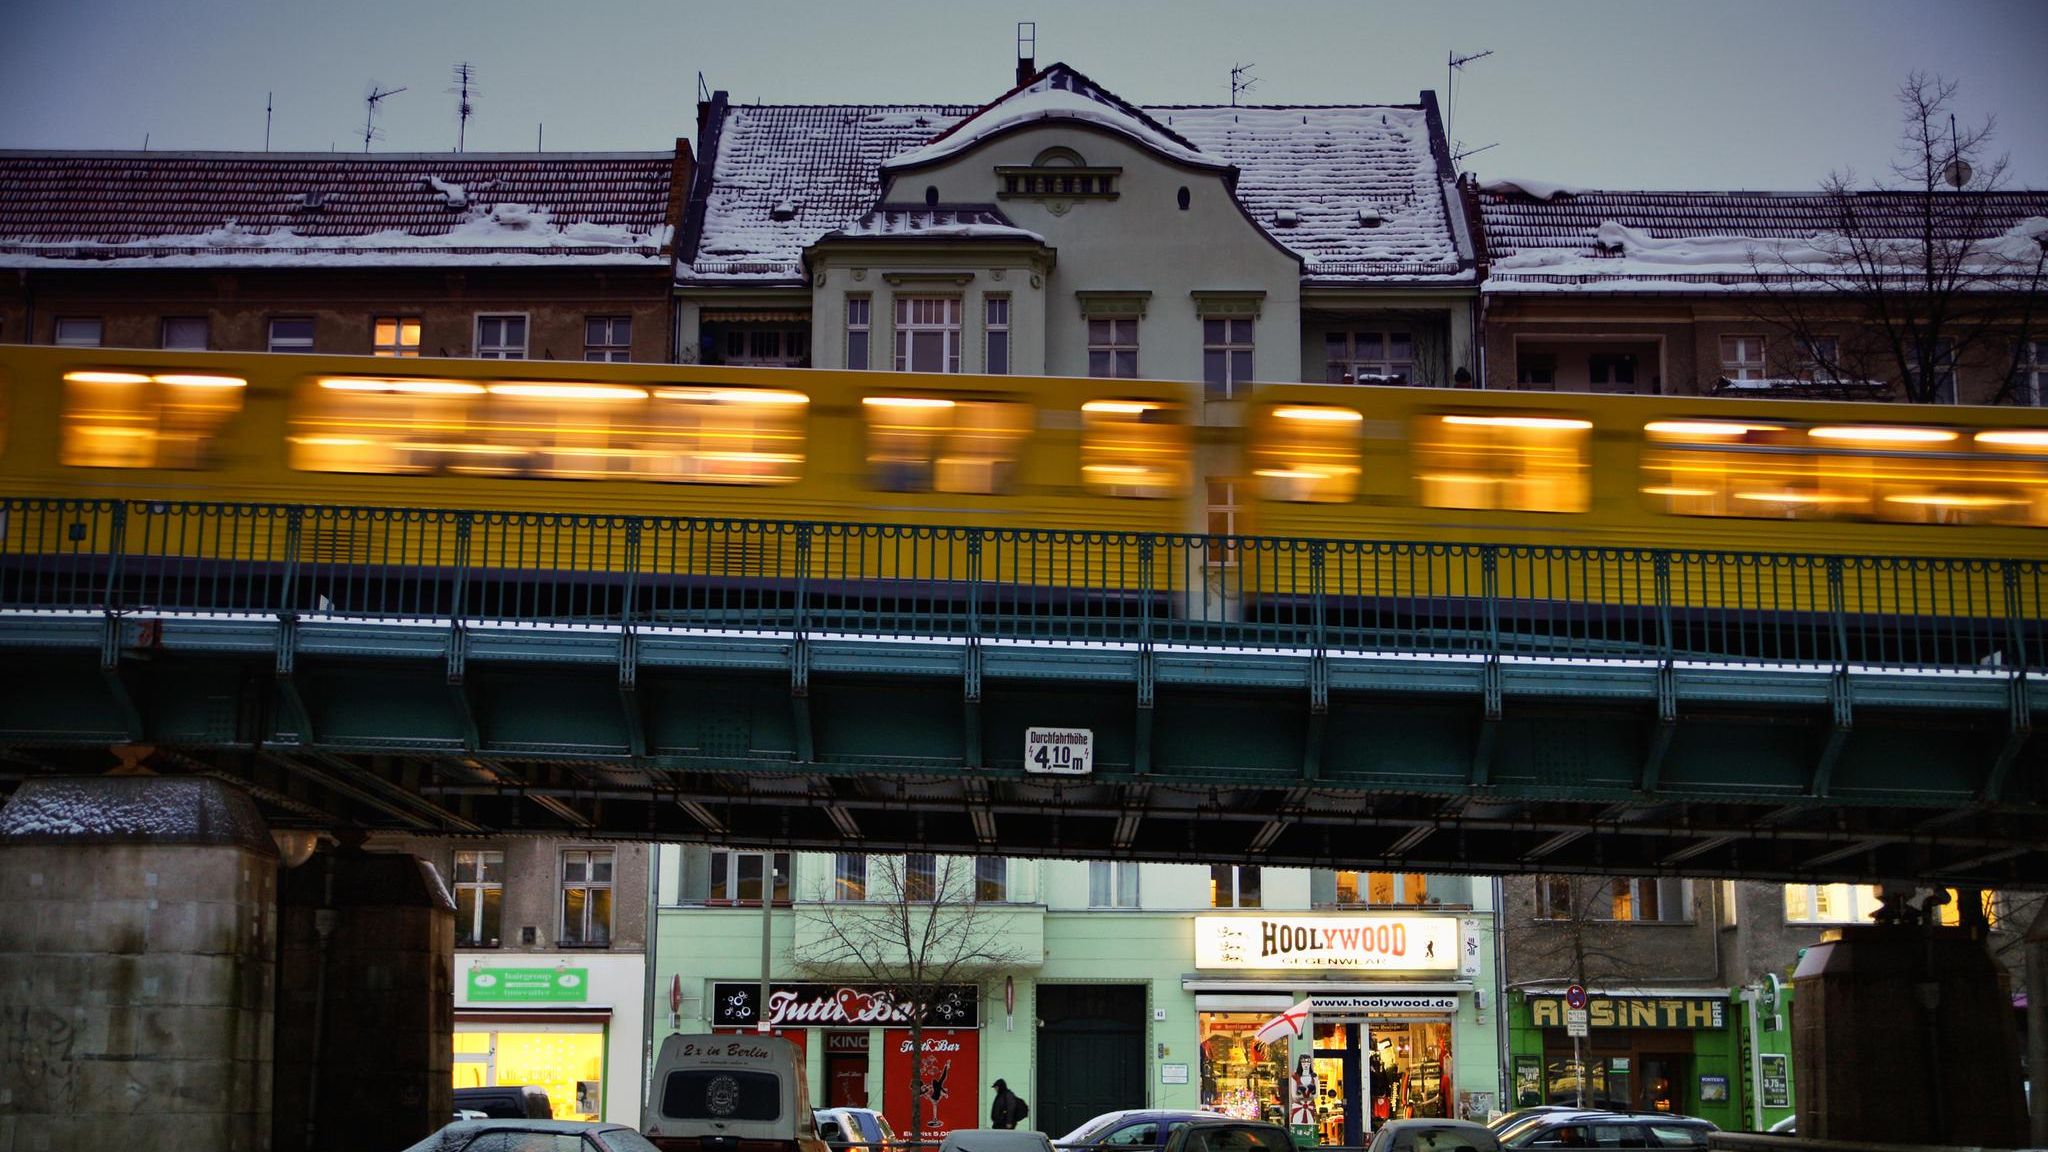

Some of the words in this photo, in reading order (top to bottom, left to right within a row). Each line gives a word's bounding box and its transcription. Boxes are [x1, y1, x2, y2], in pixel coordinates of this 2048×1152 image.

[1030, 731, 1088, 745] Durchfahrthöhe
[1034, 746, 1071, 770] 4,10
[1072, 757, 1083, 770] m
[1261, 921, 1407, 957] HOOLYWOOD
[769, 991, 853, 1024] Tutti
[1312, 999, 1454, 1007] www.hoolywood.de
[1712, 1000, 1722, 1027] BAR
[707, 1046, 720, 1056] in
[727, 1043, 769, 1059] Berlin
